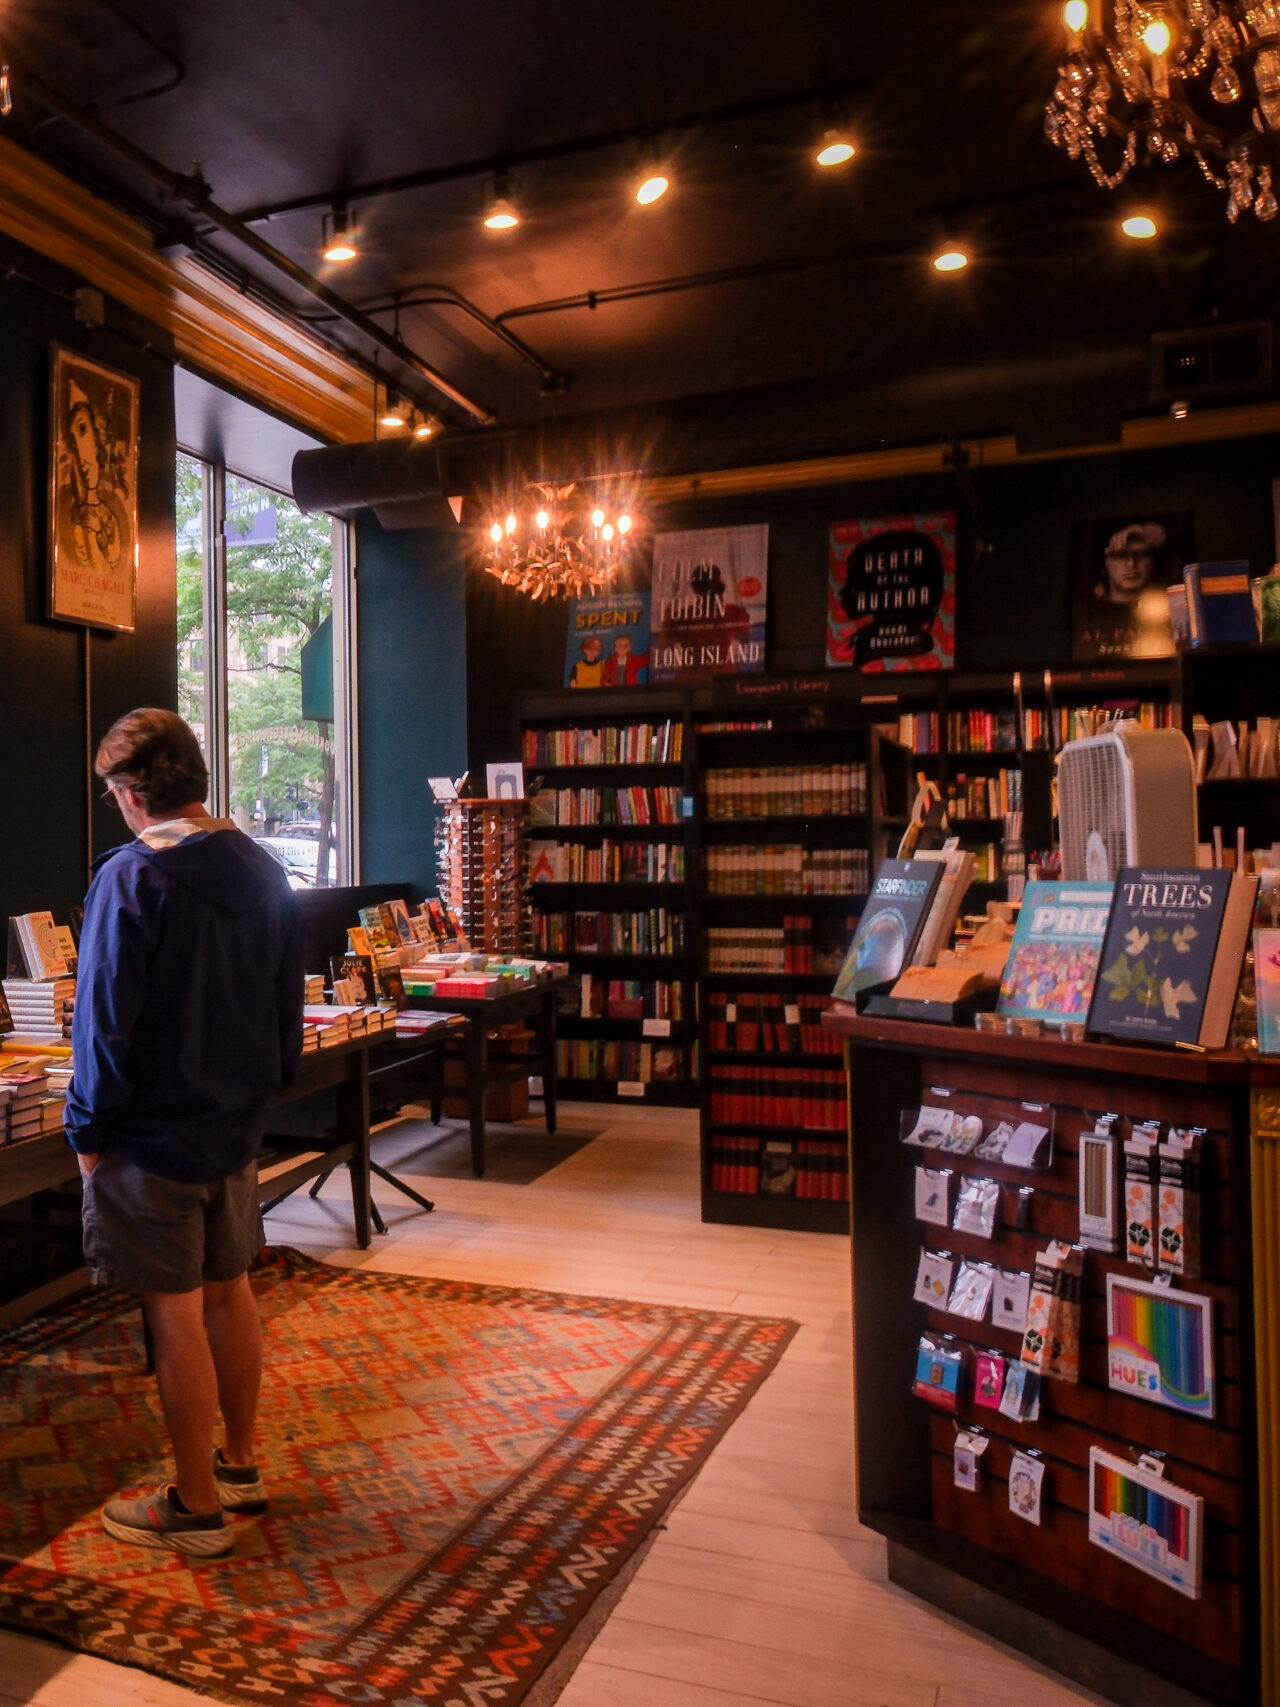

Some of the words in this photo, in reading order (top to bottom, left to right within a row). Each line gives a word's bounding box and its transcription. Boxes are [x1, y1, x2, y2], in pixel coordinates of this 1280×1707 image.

[864, 547, 924, 574] DEATH
[857, 586, 930, 613] AUTHOR
[575, 609, 643, 629] SPENT
[654, 647, 695, 669] LONG
[700, 642, 760, 667] ISLAND
[875, 878, 928, 897] STARFINDER
[1140, 871, 1200, 883] Smithsonian
[1124, 883, 1213, 909] TREES
[1030, 906, 1110, 936] PRID
[343, 959, 363, 967] JULIE
[1111, 1363, 1158, 1391] HUES
